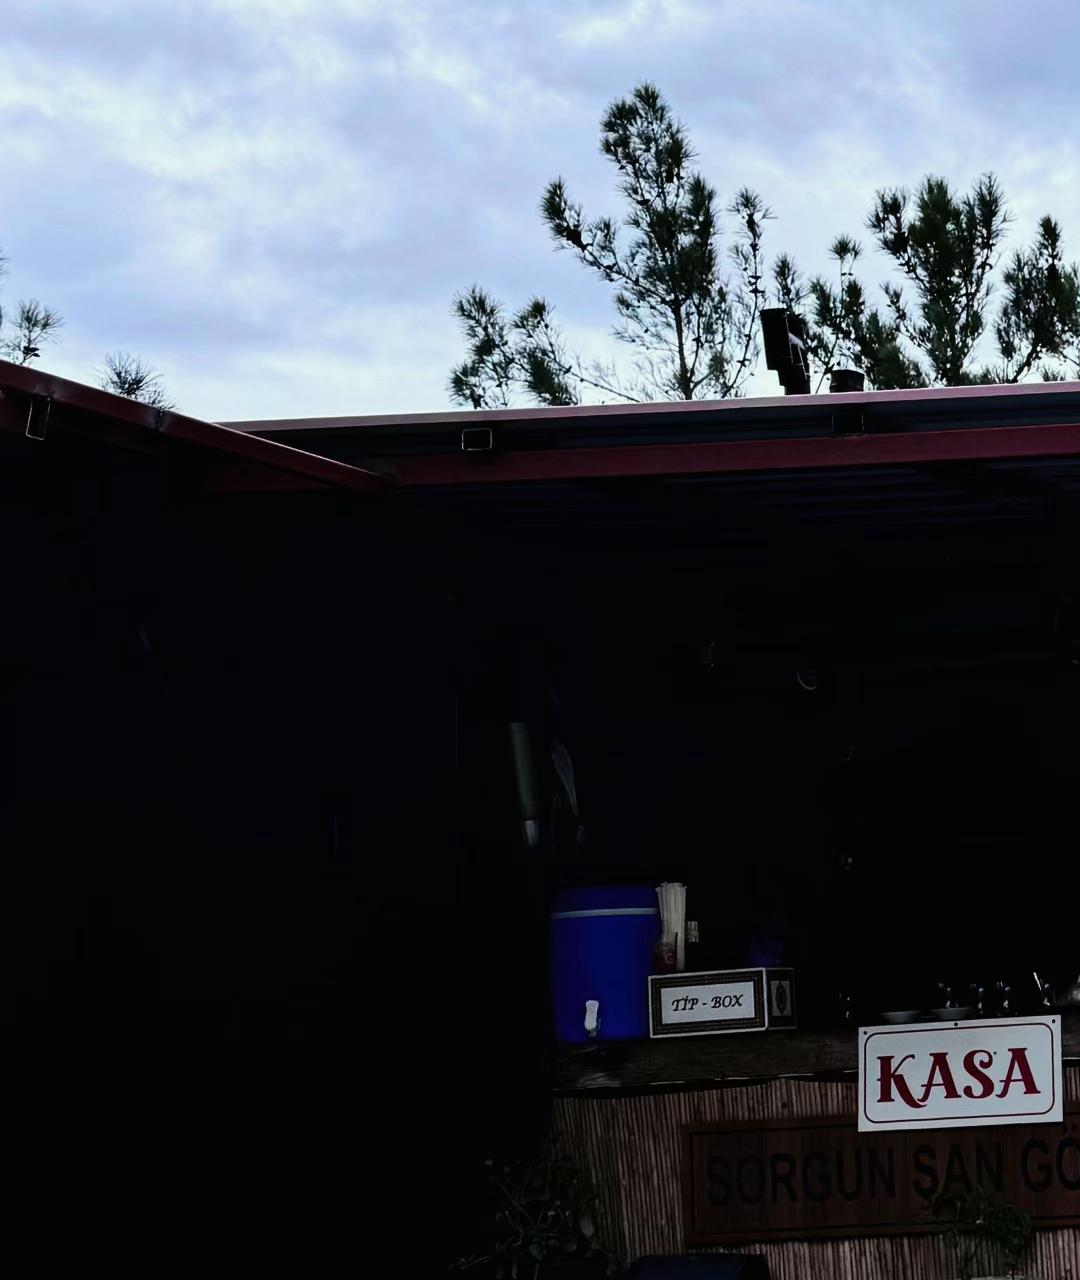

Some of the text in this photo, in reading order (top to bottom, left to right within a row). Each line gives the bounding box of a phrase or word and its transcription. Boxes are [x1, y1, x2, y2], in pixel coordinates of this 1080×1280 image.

[672, 996, 699, 1011] TİP
[711, 995, 743, 1008] BOX
[877, 1047, 1041, 1109] KASA
[706, 1146, 895, 1206] SORGUN
[911, 1141, 1004, 1209] ŞAN
